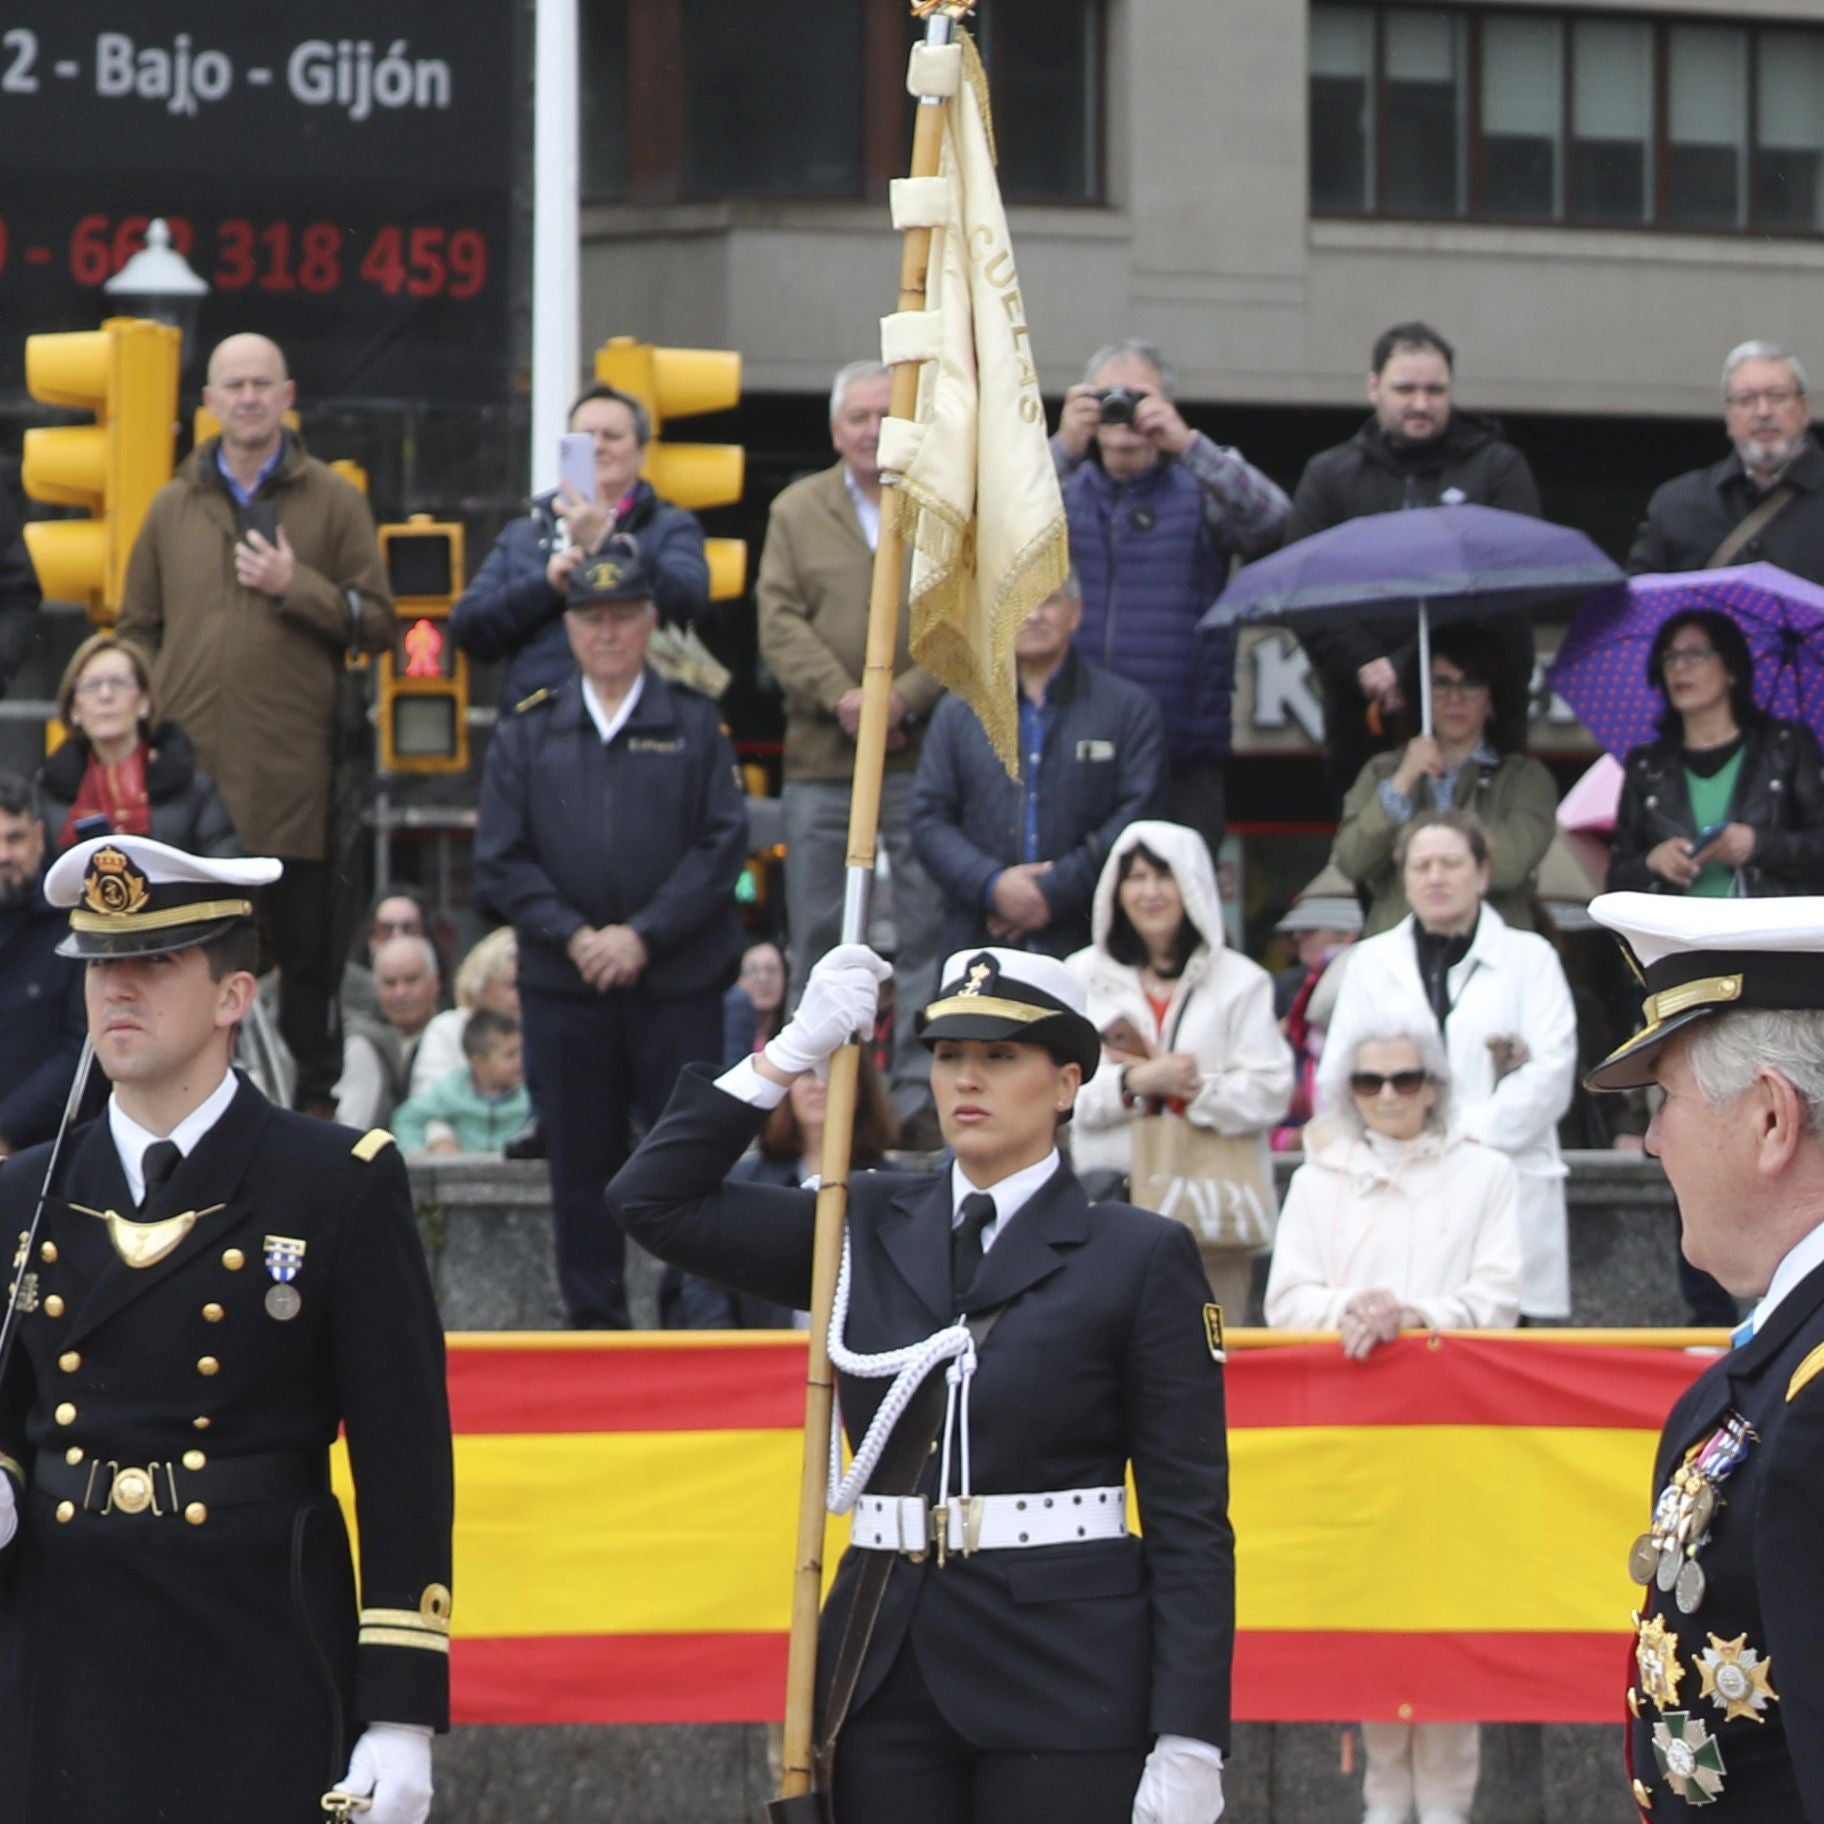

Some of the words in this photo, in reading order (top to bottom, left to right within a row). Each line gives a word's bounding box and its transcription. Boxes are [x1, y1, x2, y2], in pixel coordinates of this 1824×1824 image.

[1, 27, 40, 94] 2
[95, 31, 234, 117] Bajo
[286, 37, 452, 122] Gijón
[212, 218, 343, 293] 318
[358, 224, 488, 299] 459
